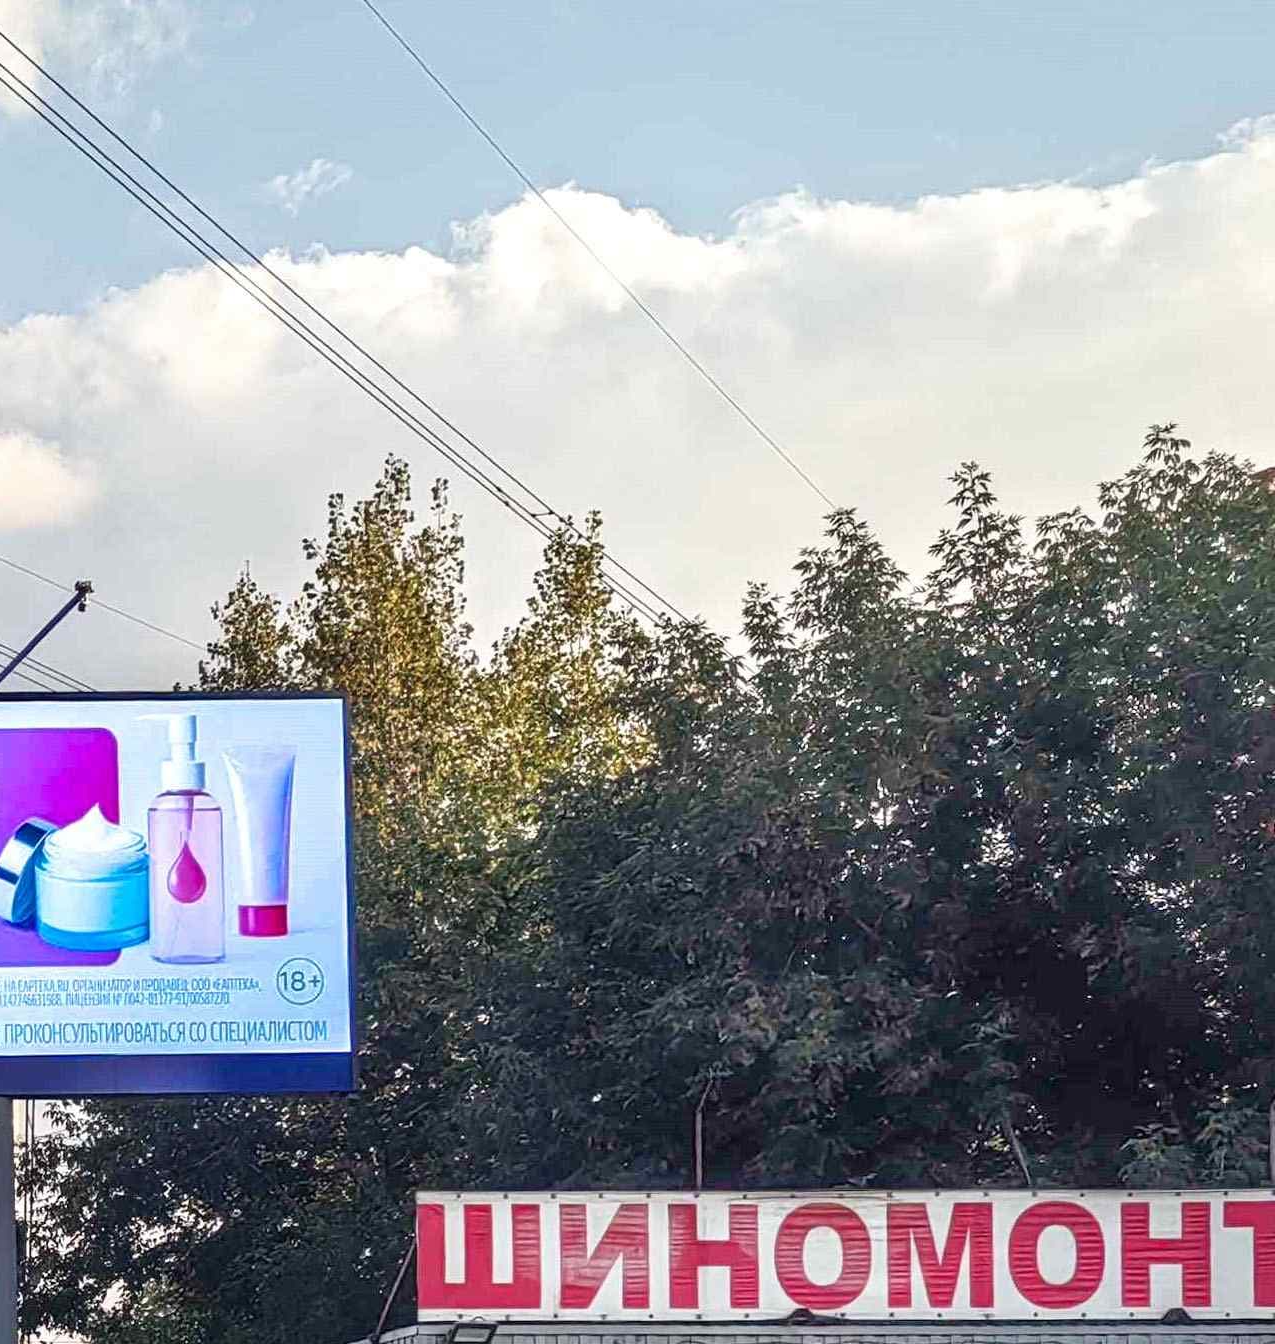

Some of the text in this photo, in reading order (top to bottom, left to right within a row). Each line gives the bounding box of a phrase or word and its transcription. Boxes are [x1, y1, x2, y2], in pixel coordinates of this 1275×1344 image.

[279, 971, 321, 992] 18+
[4, 1021, 186, 1045] ПРОКОНСУЛЬТИРОВАТЬСЯ
[189, 1022, 207, 1042] СО
[417, 1200, 1275, 1311] ШИНОМОНТ
